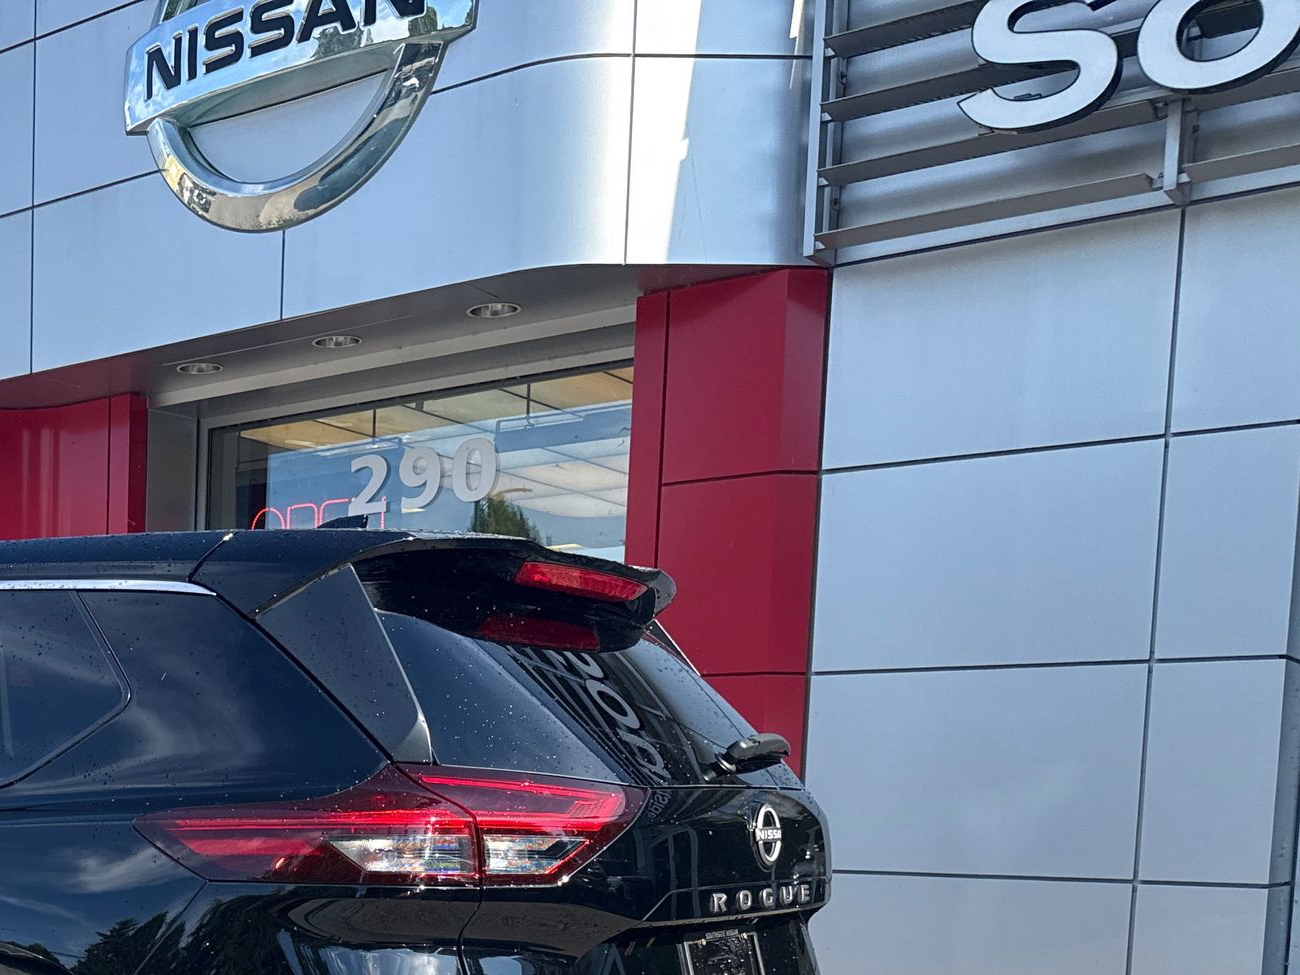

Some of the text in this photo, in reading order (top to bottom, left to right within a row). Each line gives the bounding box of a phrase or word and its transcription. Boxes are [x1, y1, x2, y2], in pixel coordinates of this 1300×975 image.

[348, 437, 497, 517] 290
[757, 829, 782, 840] NISSA
[711, 884, 810, 912] ROGUE
